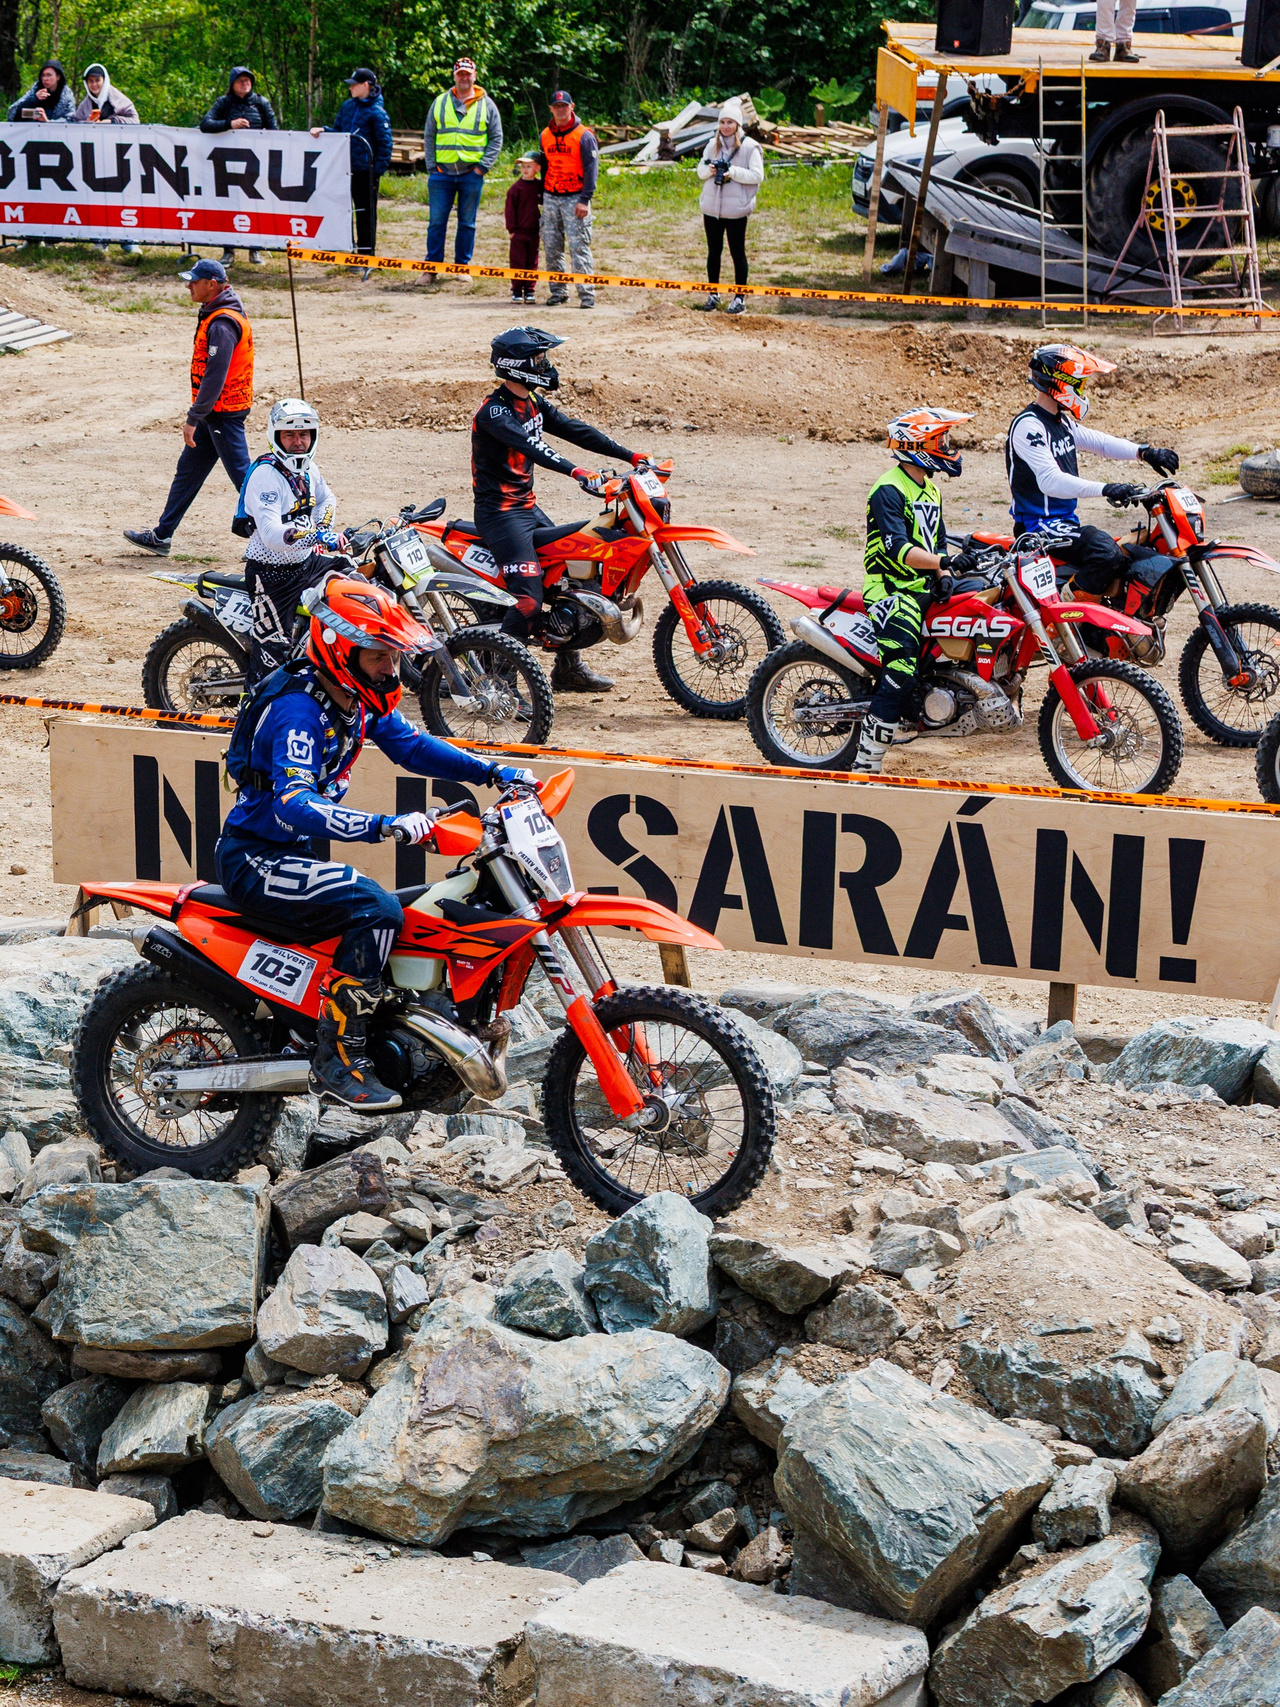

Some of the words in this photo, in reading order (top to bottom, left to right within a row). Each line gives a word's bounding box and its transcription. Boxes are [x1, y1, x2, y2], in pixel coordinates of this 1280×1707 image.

[497, 358, 526, 367] LEATT
[407, 549, 424, 565] 110
[469, 550, 497, 569] 104
[1033, 570, 1054, 590] 135
[315, 607, 373, 648] 100%
[850, 622, 877, 645] 135
[922, 616, 1013, 637] ASGAS
[518, 851, 535, 867] PATSEV
[533, 865, 548, 881] BORIS
[396, 777, 1206, 983] PSARÁN!
[151, 943, 172, 959] KTM
[250, 952, 303, 988] 103
